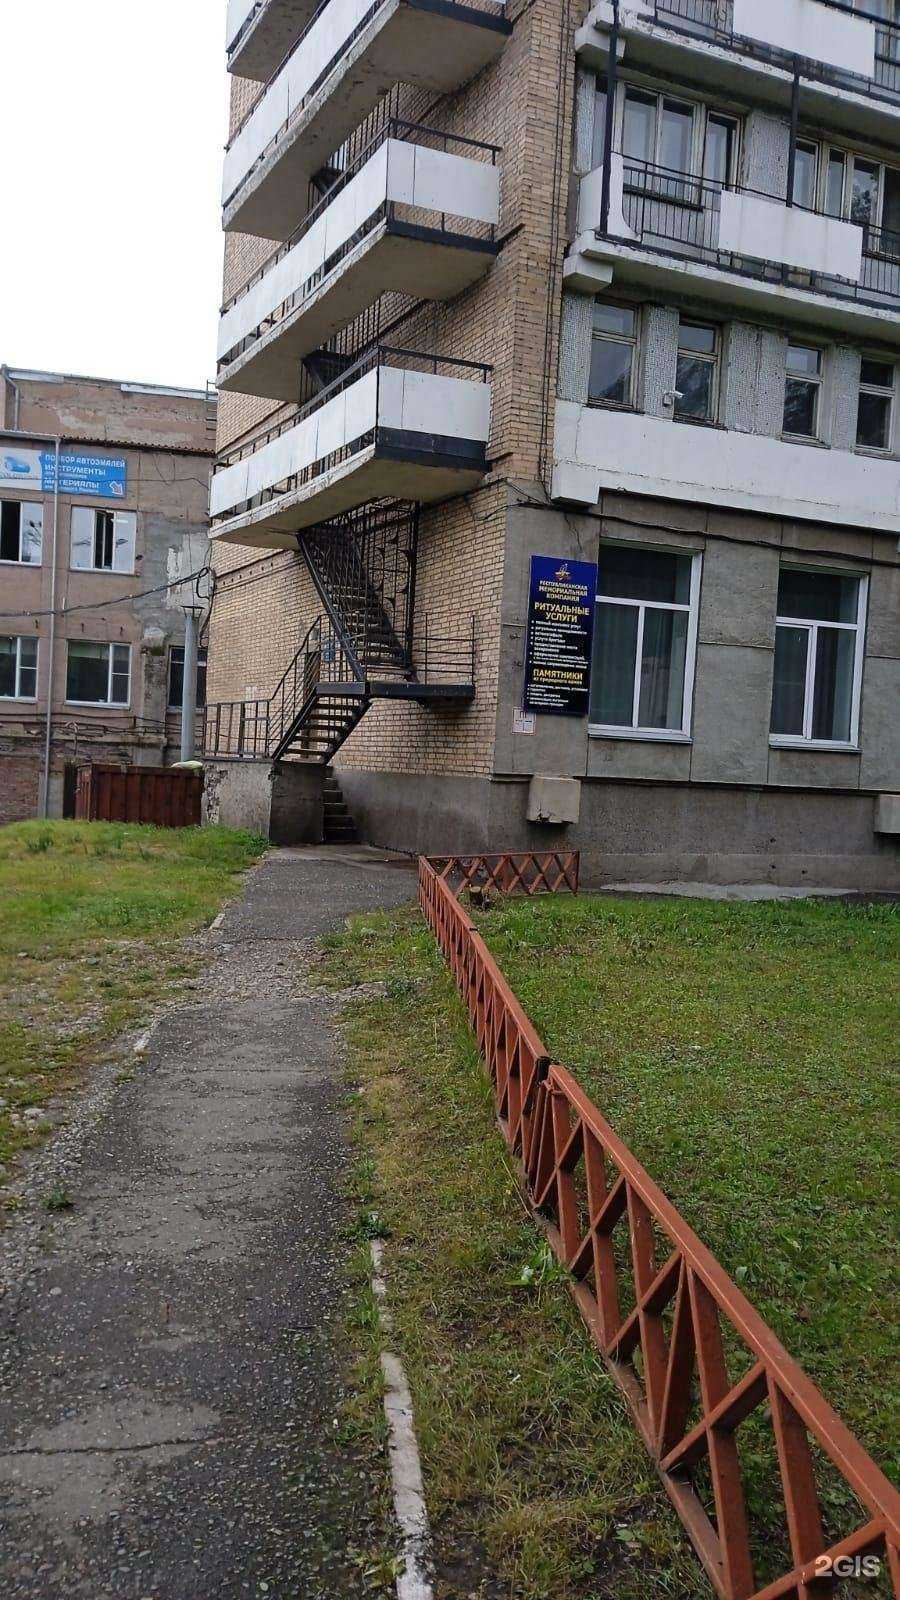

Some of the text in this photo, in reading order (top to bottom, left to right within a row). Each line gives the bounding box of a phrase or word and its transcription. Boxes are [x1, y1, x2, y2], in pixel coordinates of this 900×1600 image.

[45, 455, 75, 463] ПОБОР
[546, 593, 580, 602] КОМПАНИЯ
[534, 602, 590, 616] РИТУАЛЬНЫЕ
[545, 612, 578, 623] УСЛУГИ
[533, 668, 583, 680] ПАМЯТНИКИ
